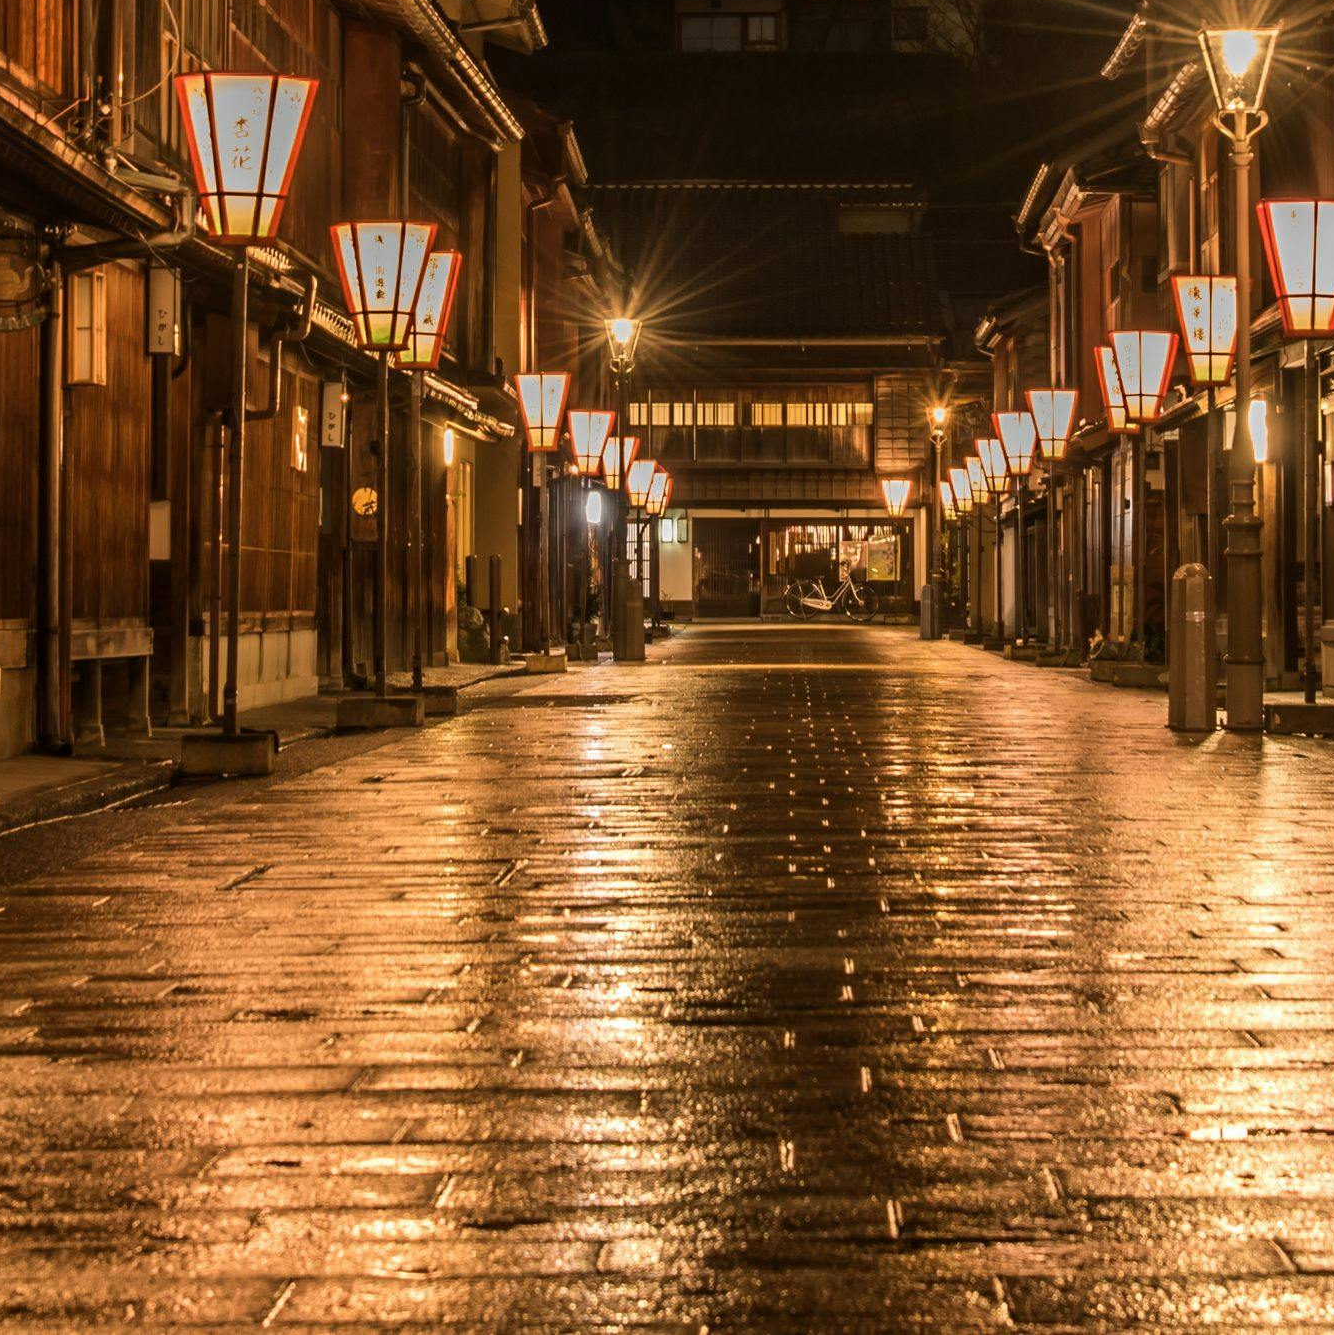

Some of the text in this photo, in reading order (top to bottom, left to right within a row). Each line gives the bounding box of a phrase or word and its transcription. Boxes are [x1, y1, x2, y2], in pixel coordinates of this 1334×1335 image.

[157, 309, 168, 346] ひがし
[328, 412, 336, 442] ひがし
